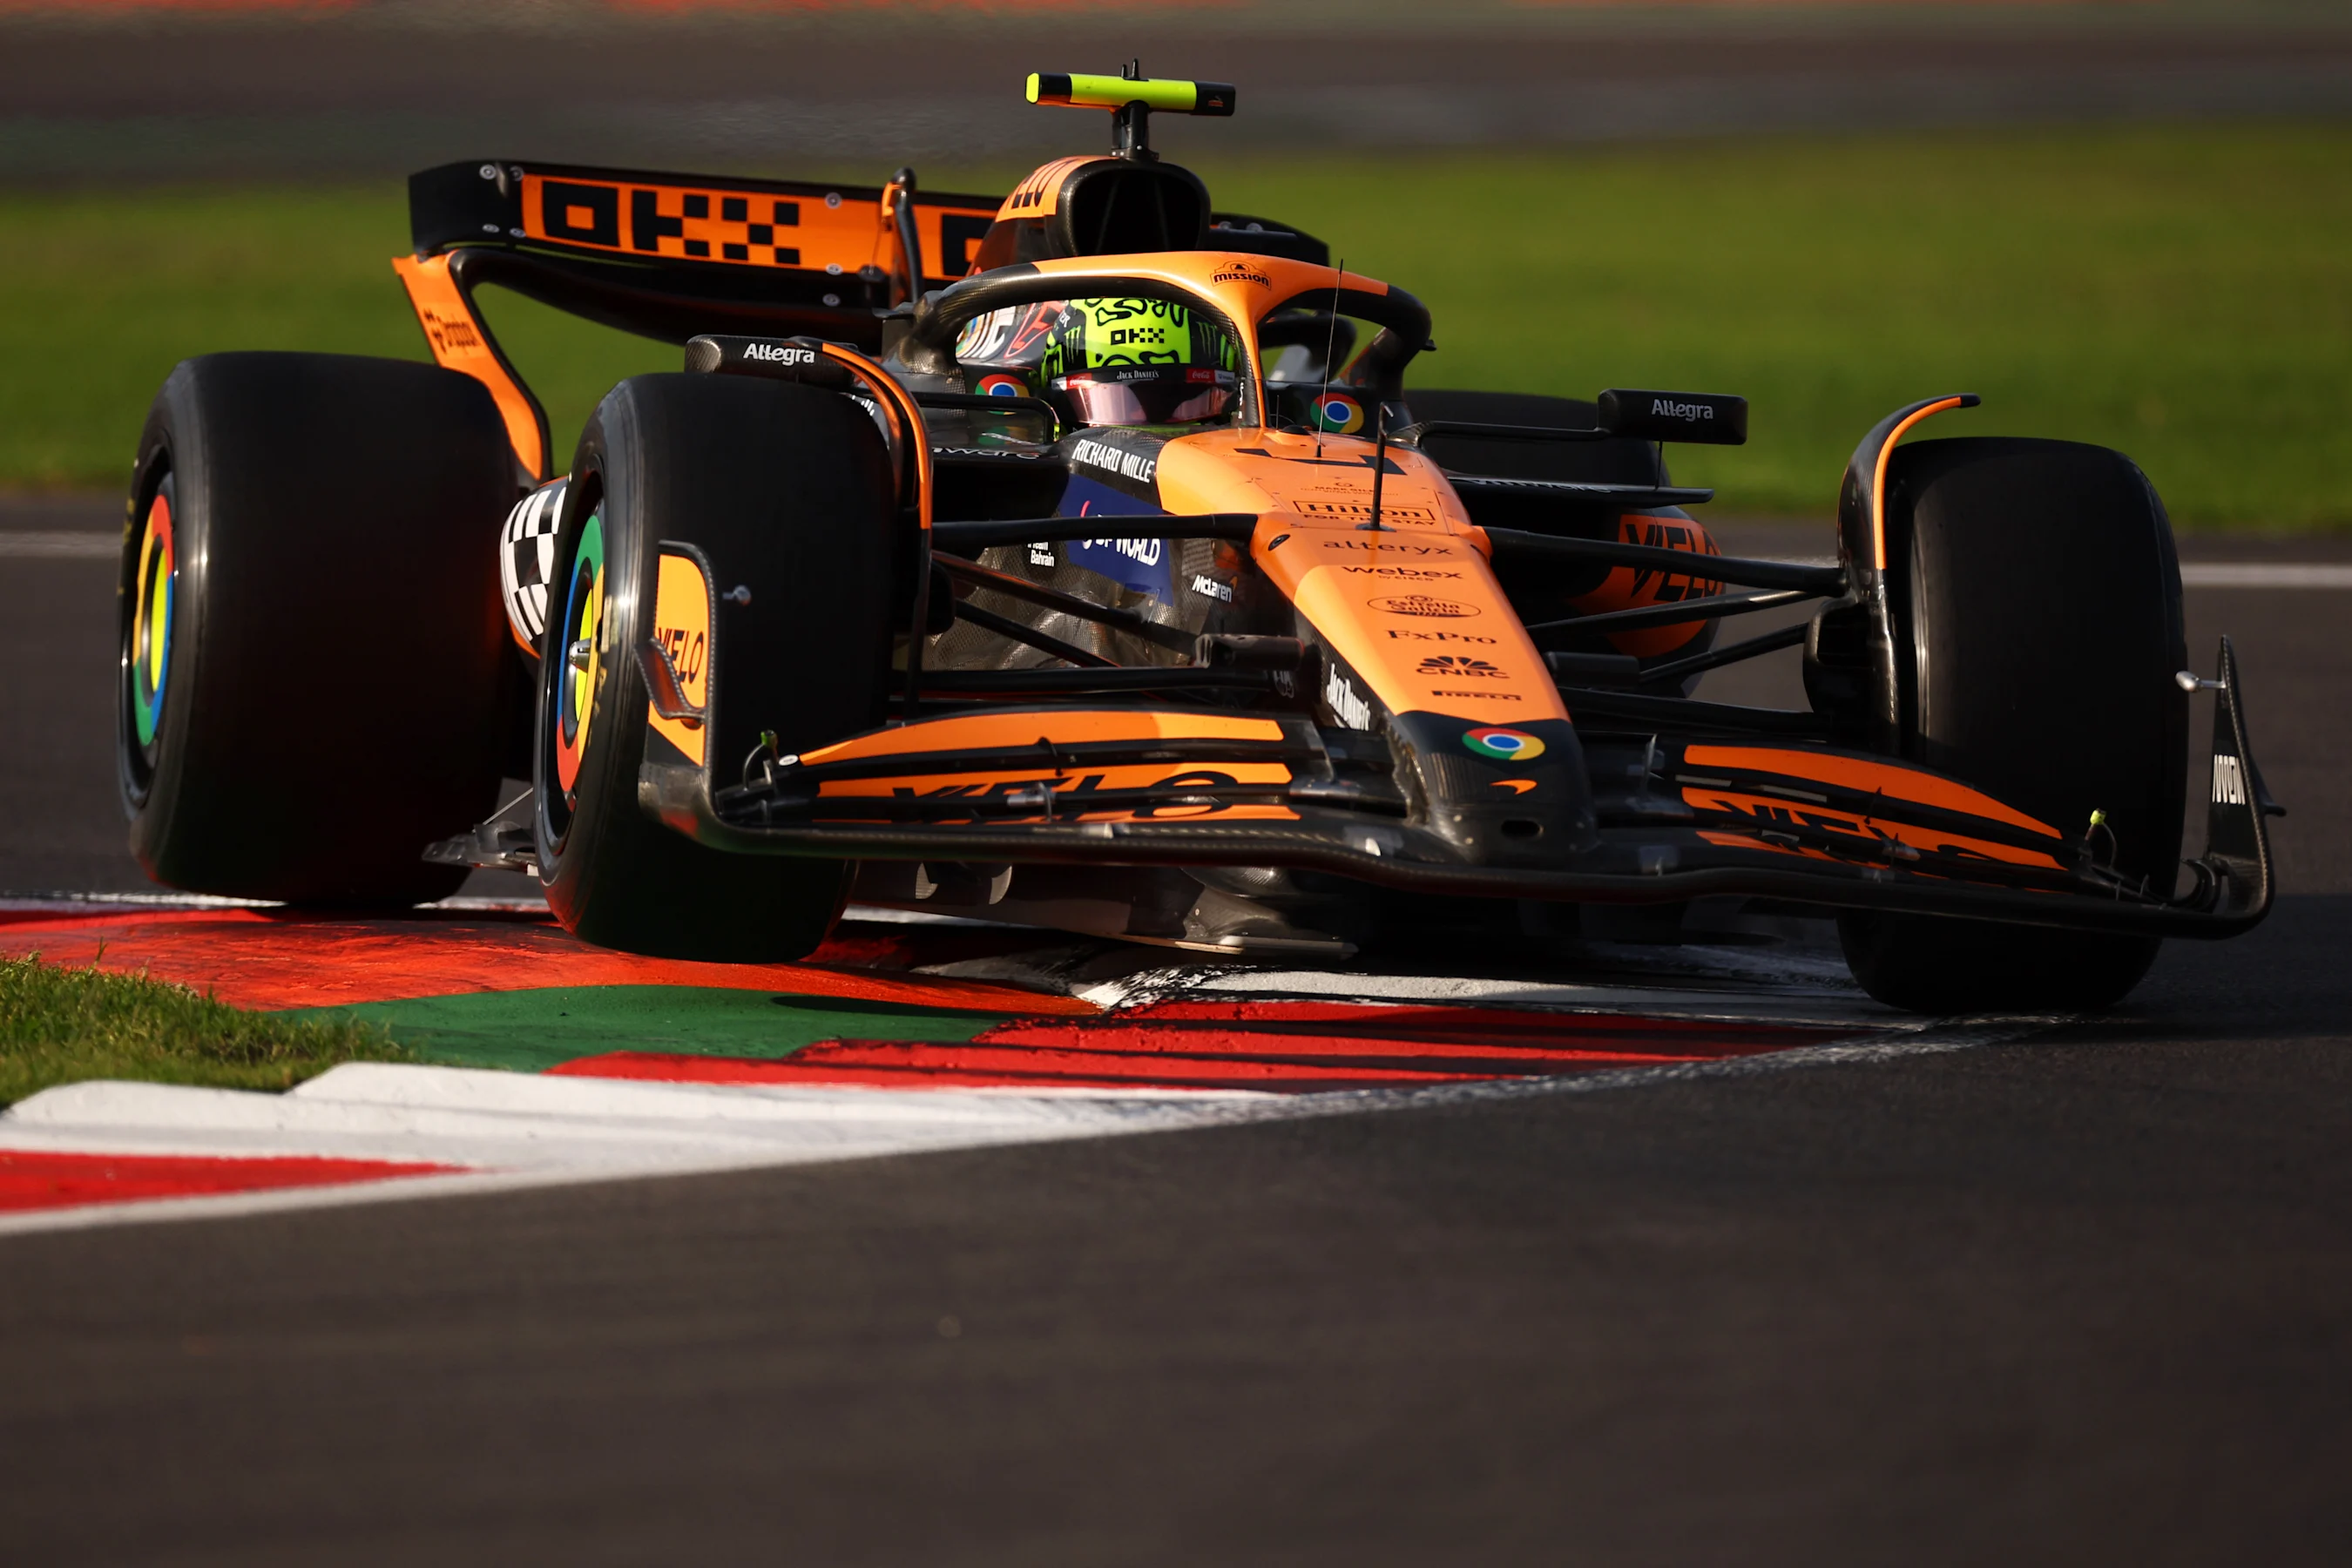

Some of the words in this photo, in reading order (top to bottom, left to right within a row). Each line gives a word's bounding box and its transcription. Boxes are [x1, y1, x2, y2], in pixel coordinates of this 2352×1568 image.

[541, 180, 801, 266] OKX
[1111, 328, 1165, 345] OKX
[743, 342, 815, 366] Allegra
[1652, 399, 1713, 422] Allegra
[1071, 439, 1123, 472] RICHARD
[1120, 452, 1156, 483] MILLE
[1308, 504, 1422, 518] Hilton
[1323, 540, 1454, 555] alteryx
[1031, 550, 1055, 567] Bahrain
[1342, 566, 1464, 579] webex
[1192, 575, 1233, 603] McLaren
[1385, 630, 1497, 645] FxPro
[1416, 667, 1511, 679] CNBC
[892, 770, 1239, 822] VELO
